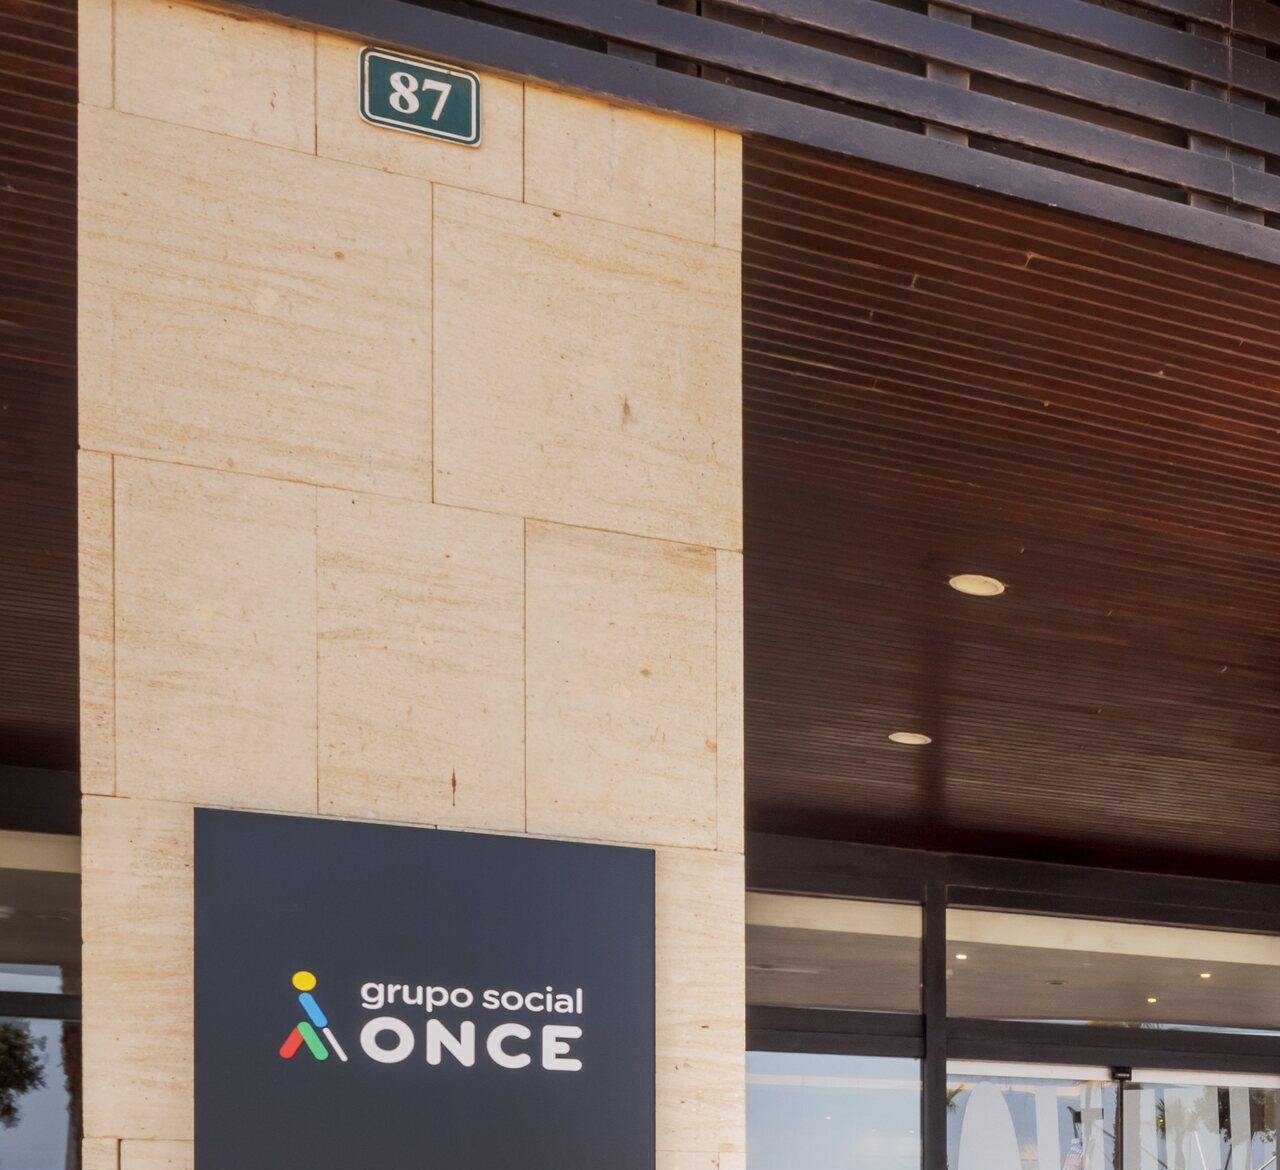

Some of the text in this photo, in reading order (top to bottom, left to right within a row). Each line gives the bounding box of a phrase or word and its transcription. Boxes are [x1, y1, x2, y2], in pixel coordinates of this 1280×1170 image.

[388, 71, 452, 121] 87
[360, 982, 583, 1014] grupo social
[359, 1016, 583, 1072] ONCE
